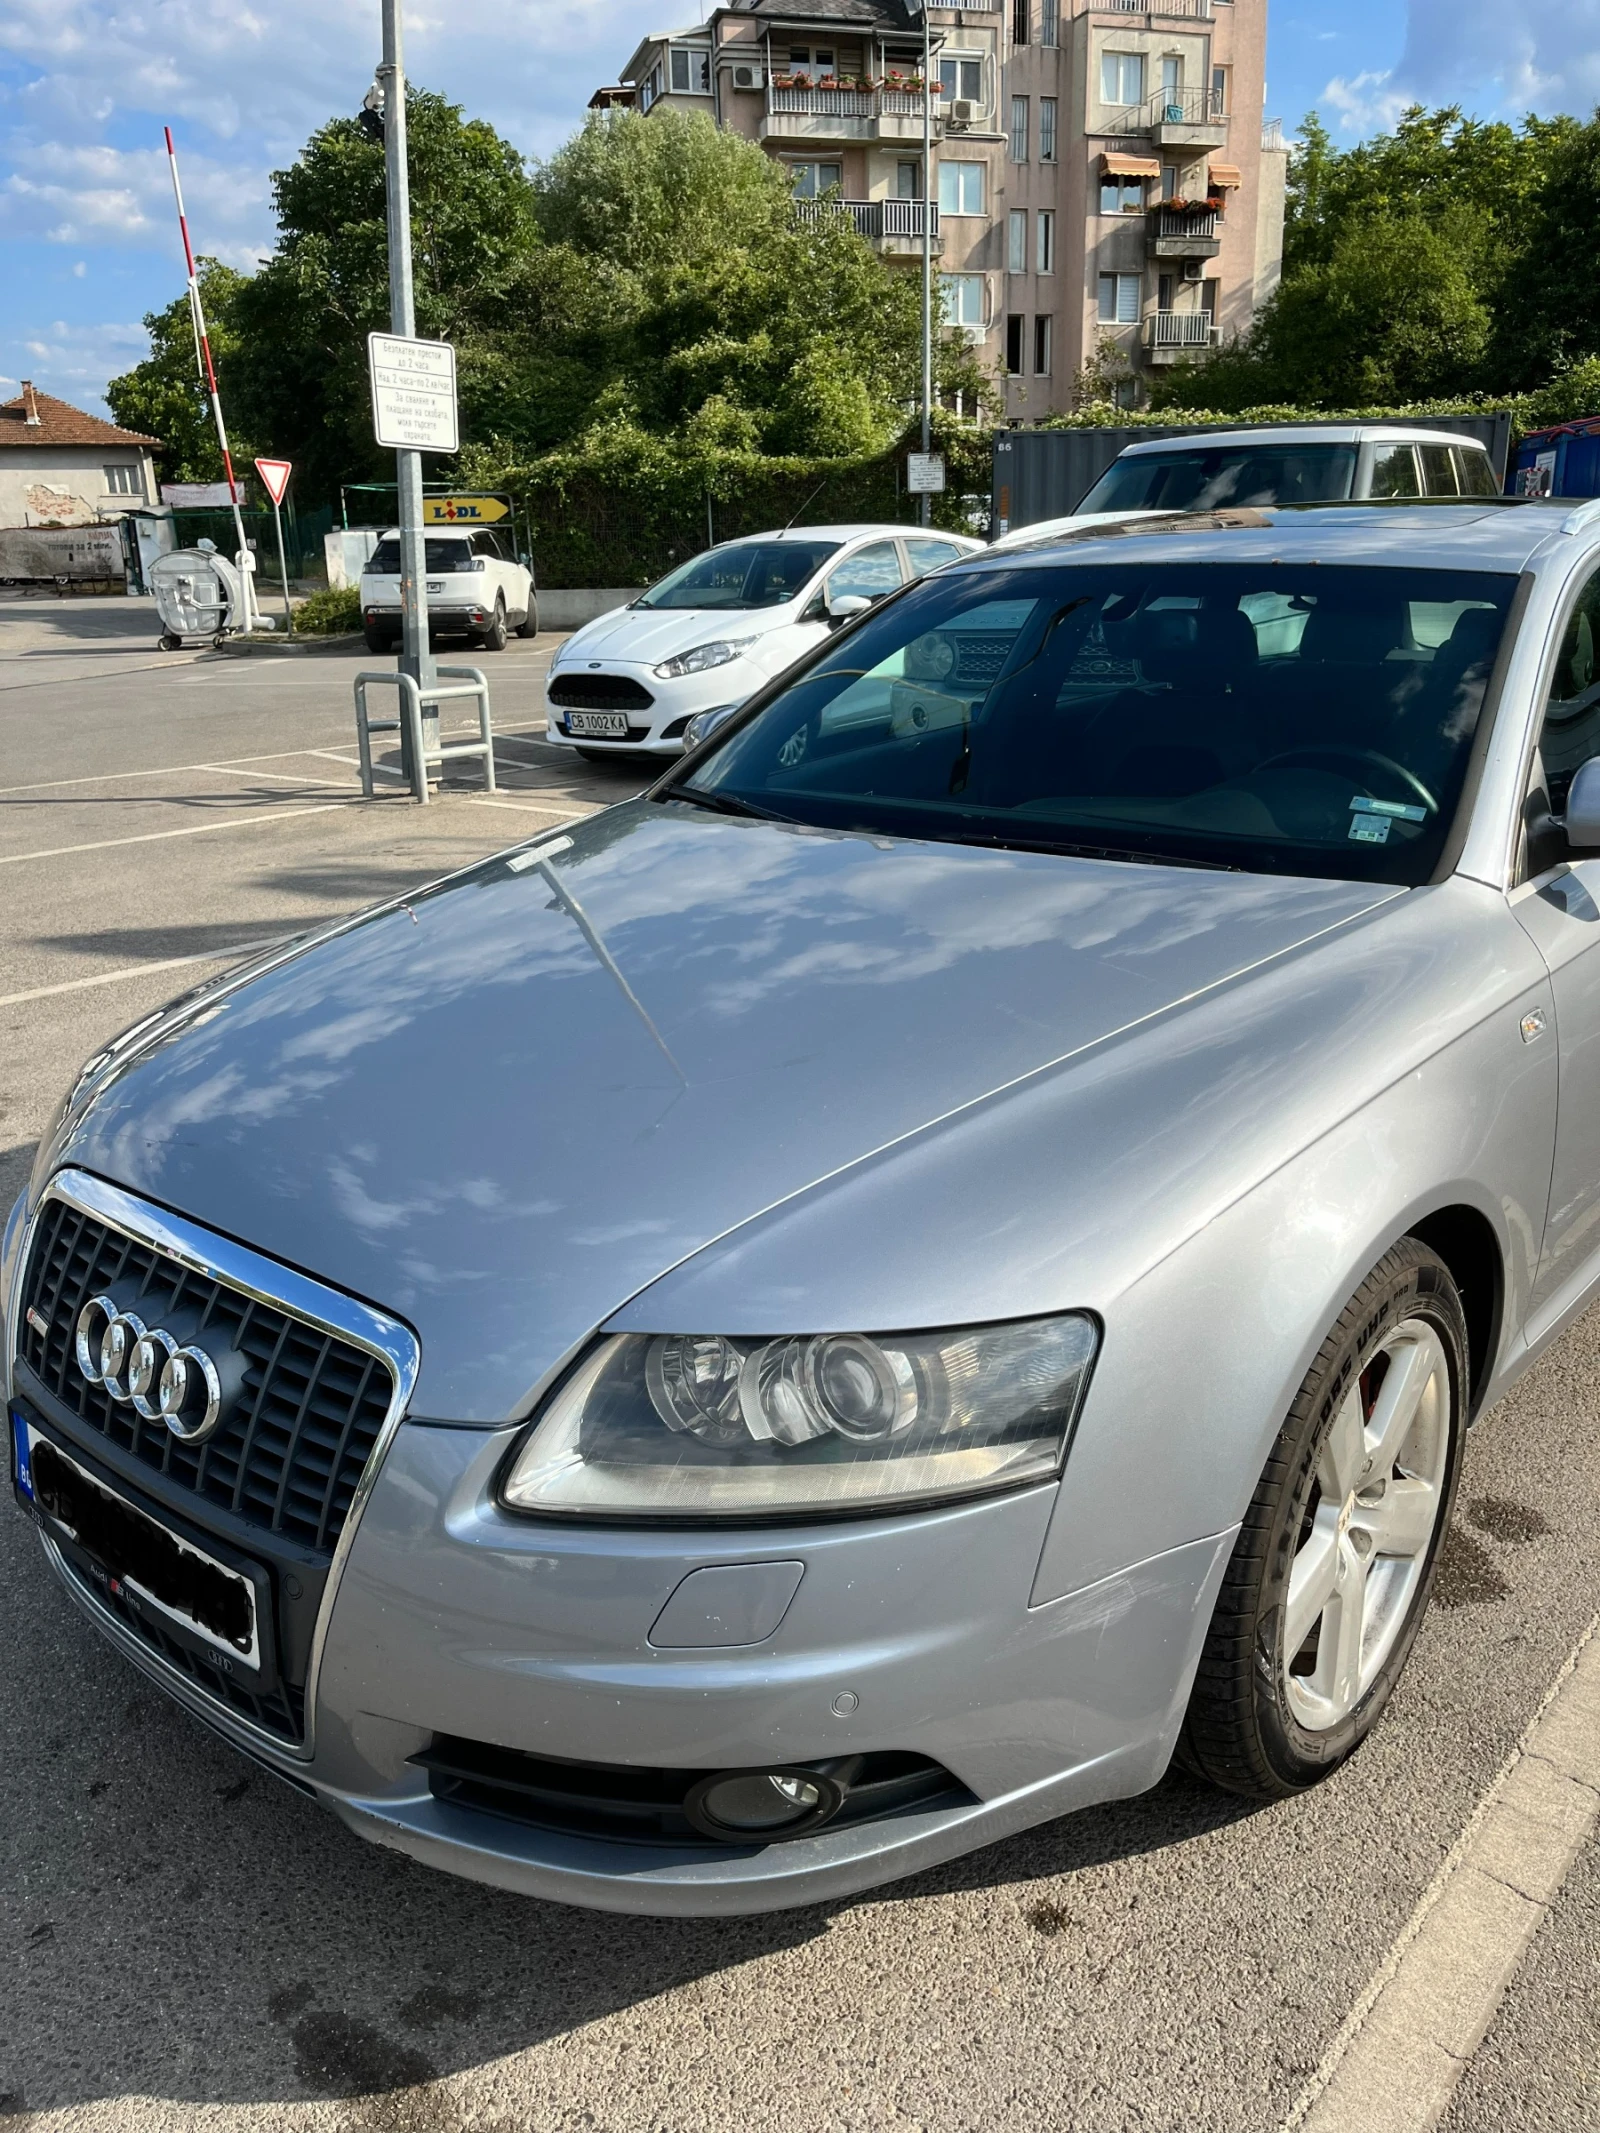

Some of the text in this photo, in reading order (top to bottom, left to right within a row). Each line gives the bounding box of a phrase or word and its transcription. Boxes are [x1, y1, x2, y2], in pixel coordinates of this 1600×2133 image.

[383, 342, 442, 360] Безплатен престой
[398, 358, 429, 370] до 2 часа
[377, 372, 391, 383] Над
[392, 373, 397, 383] 2
[425, 378, 430, 388] 2
[395, 391, 404, 402] За
[405, 394, 430, 404] сваляне
[385, 404, 413, 416] плащане
[415, 409, 422, 417] на
[397, 419, 437, 430] моля търсете
[1357, 1301, 1389, 1355] UHP
[1393, 1284, 1409, 1302] PRO
[90, 1564, 108, 1584] Audi
